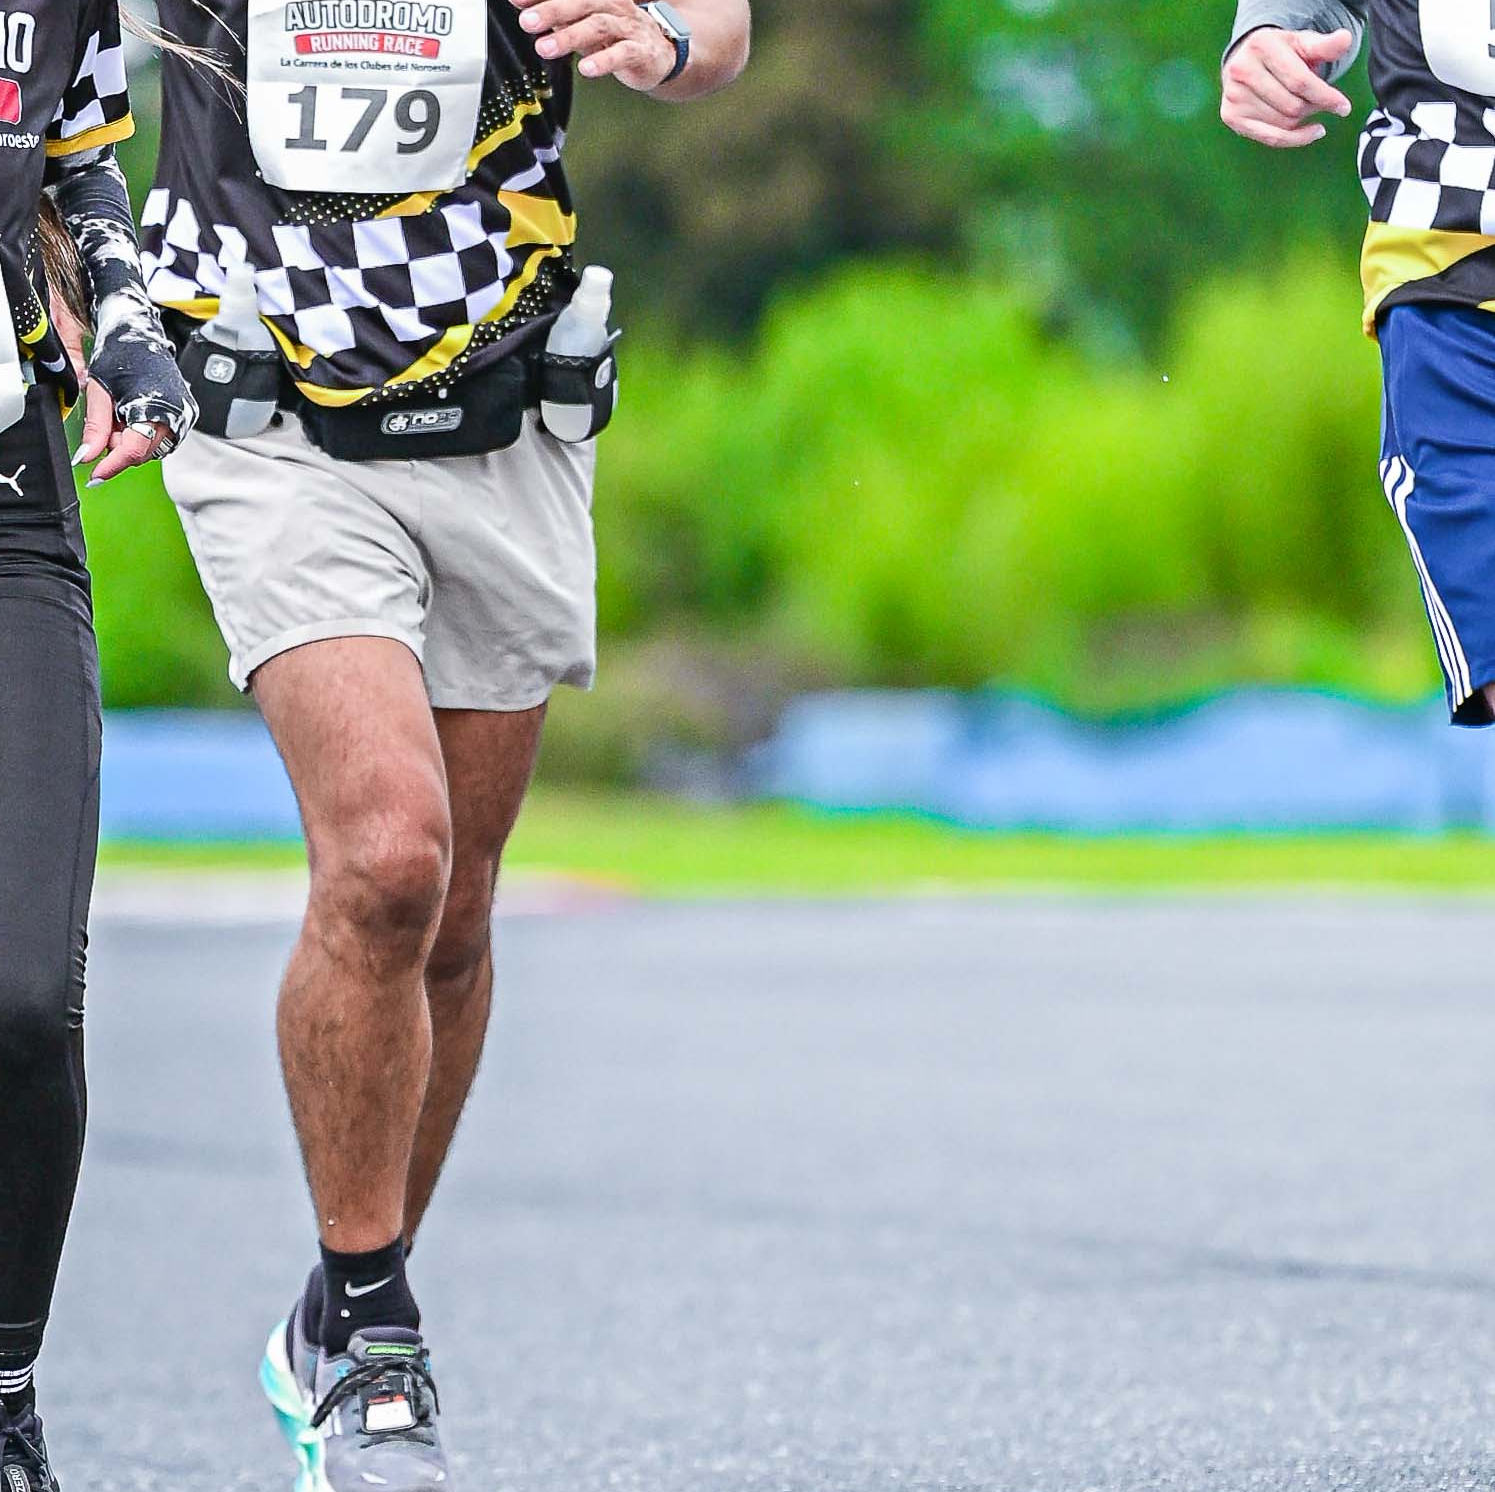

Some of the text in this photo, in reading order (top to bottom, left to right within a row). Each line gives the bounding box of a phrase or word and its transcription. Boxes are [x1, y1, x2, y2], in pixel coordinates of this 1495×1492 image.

[309, 34, 425, 55] RUNNING RACE
[280, 58, 451, 72] La Carrera de los Clubes del Noroeste
[284, 86, 441, 155] 179
